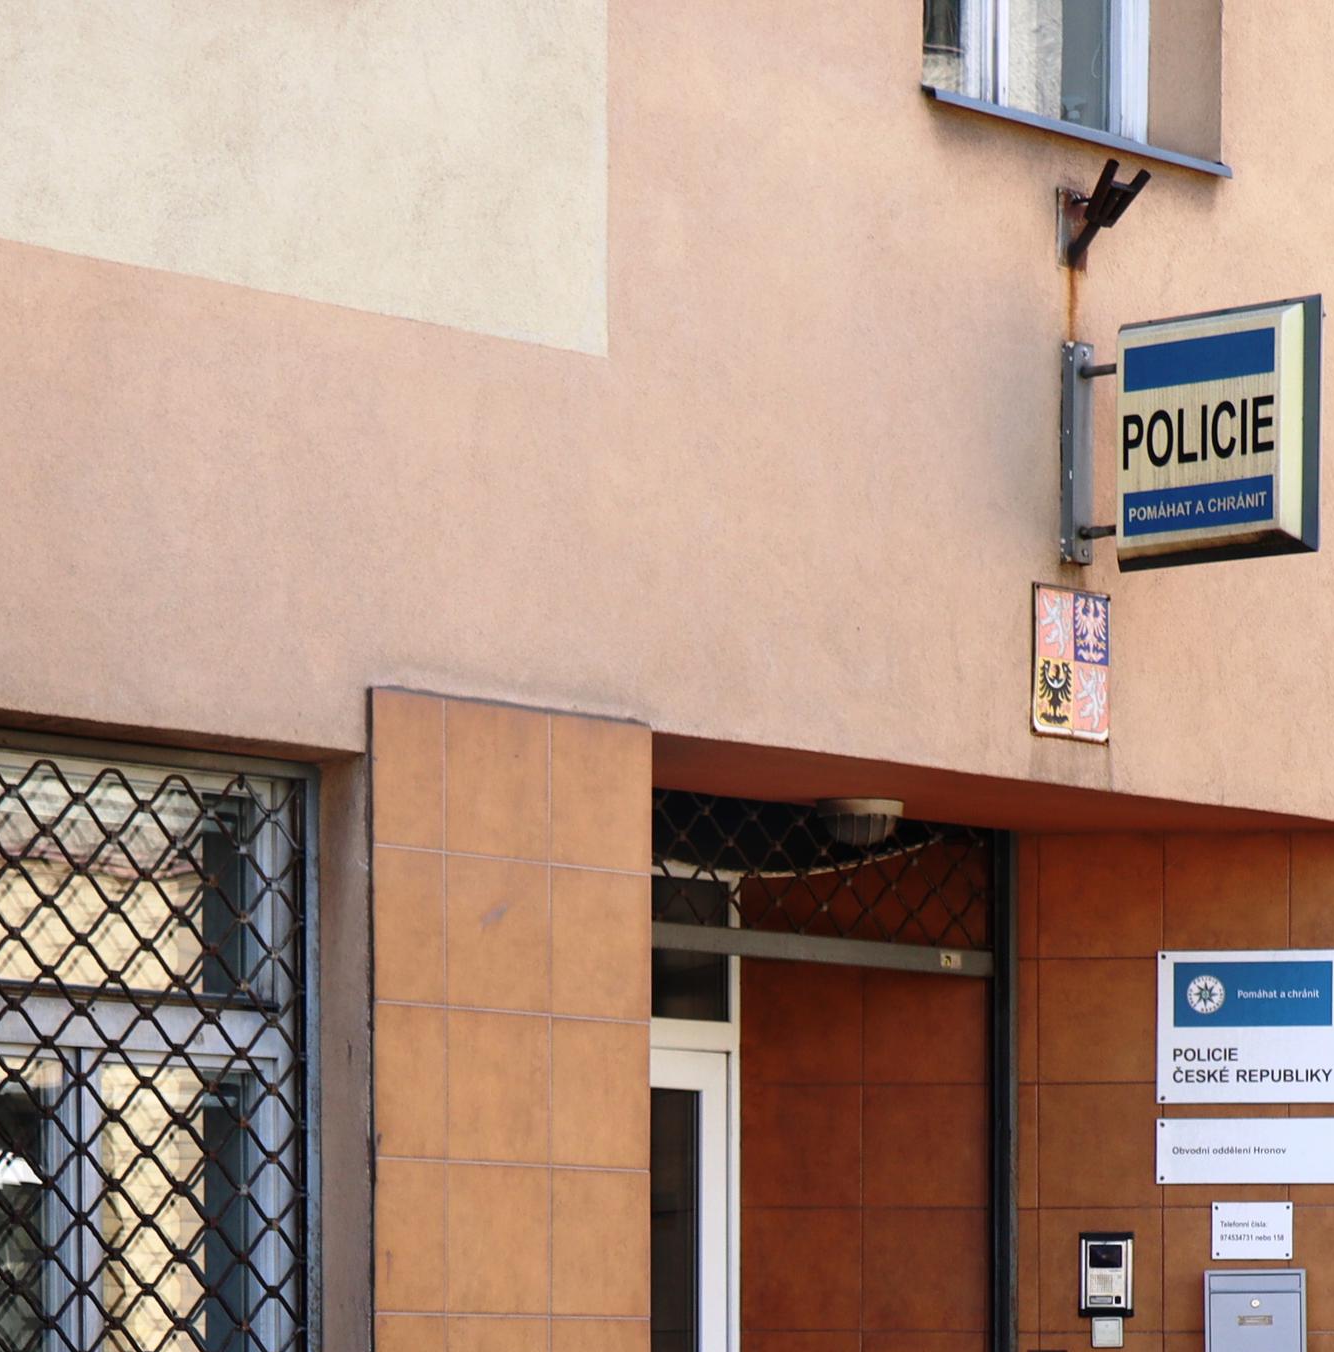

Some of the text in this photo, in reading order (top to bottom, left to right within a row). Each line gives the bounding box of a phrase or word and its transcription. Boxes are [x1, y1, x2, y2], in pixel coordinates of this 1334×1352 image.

[1122, 394, 1274, 470] POLICIE
[1128, 491, 1267, 523] POMÁHAT A CHRÁNIT
[1237, 988, 1320, 1000] Pomáhat a chránit
[1172, 1047, 1239, 1062] POLICIE
[1172, 1066, 1333, 1083] ČESKÉ REPUBLIKY
[1172, 1145, 1210, 1155] Obvodní
[1253, 1146, 1287, 1155] Hronov
